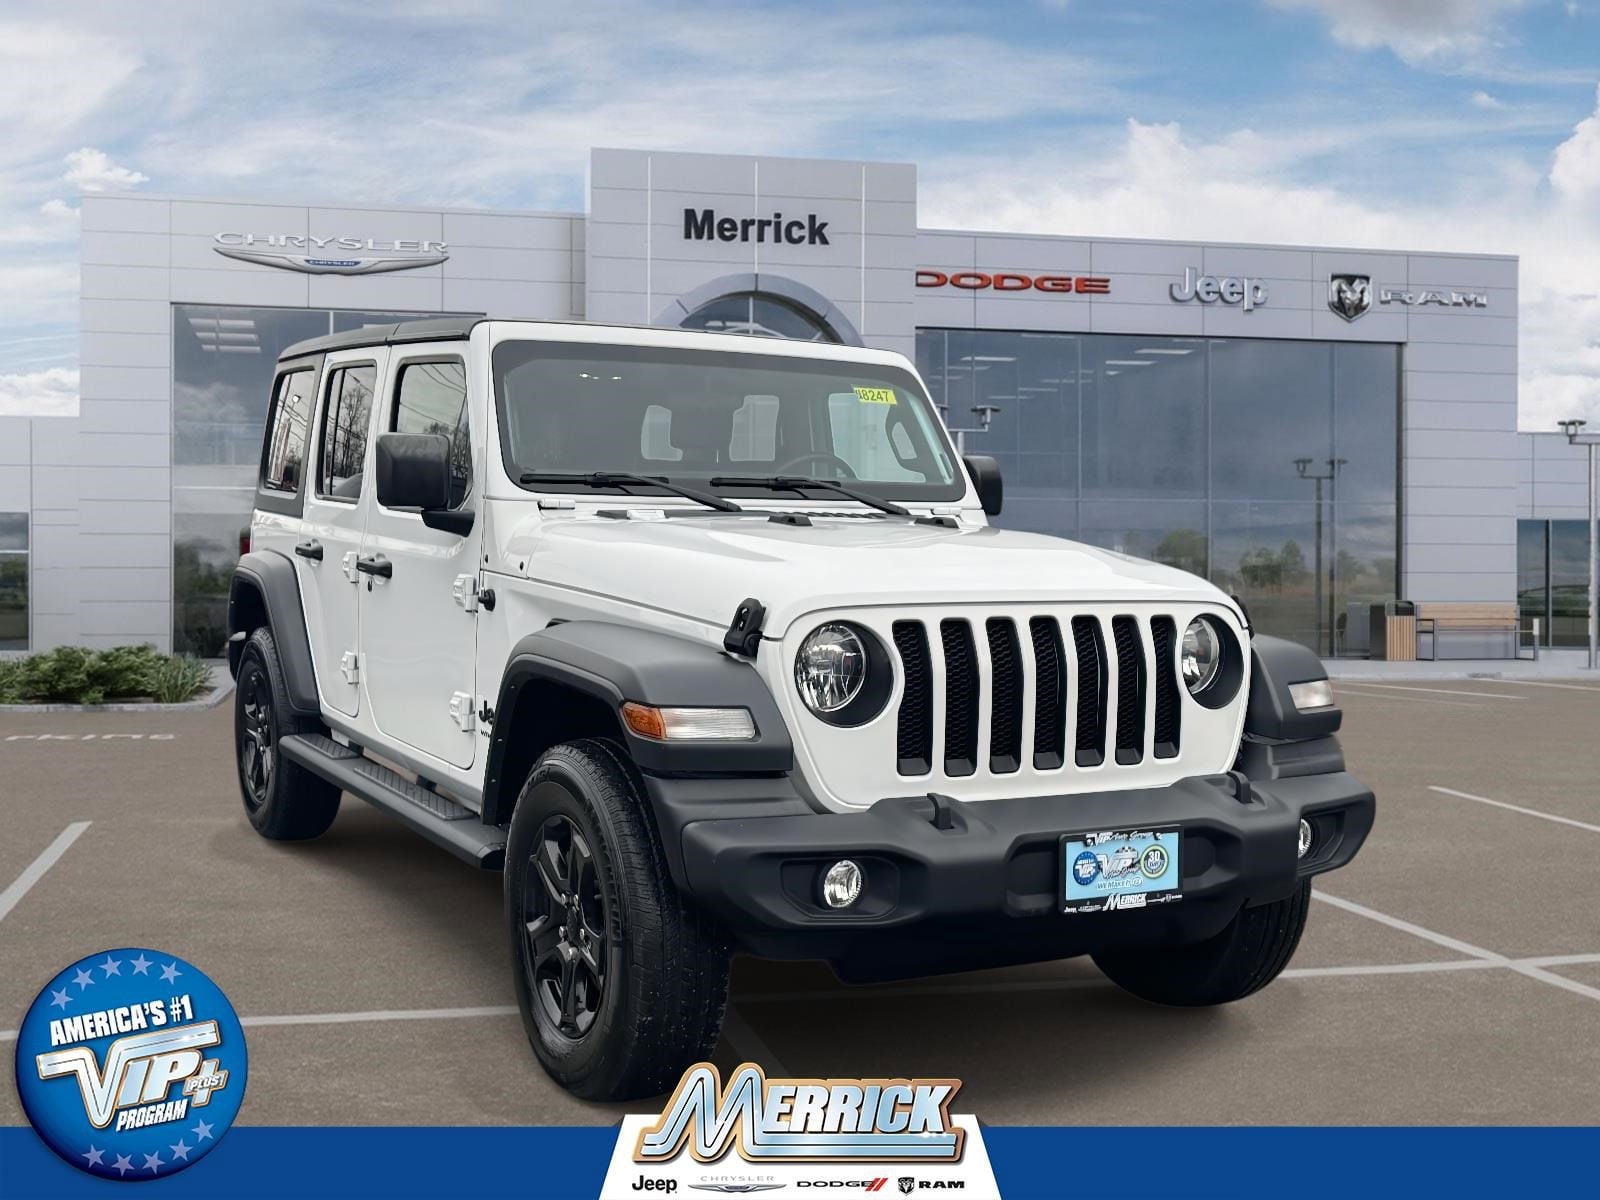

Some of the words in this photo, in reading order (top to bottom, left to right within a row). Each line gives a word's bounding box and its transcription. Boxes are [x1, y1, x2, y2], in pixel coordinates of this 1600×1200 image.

[683, 208, 830, 247] Merrick
[213, 230, 449, 254] CHRYSLER
[915, 270, 1111, 295] DODGE
[1170, 266, 1269, 312] Jeep
[1379, 287, 1488, 308] RAM
[1095, 851, 1137, 879] VIP
[1102, 892, 1147, 911] MERRICK
